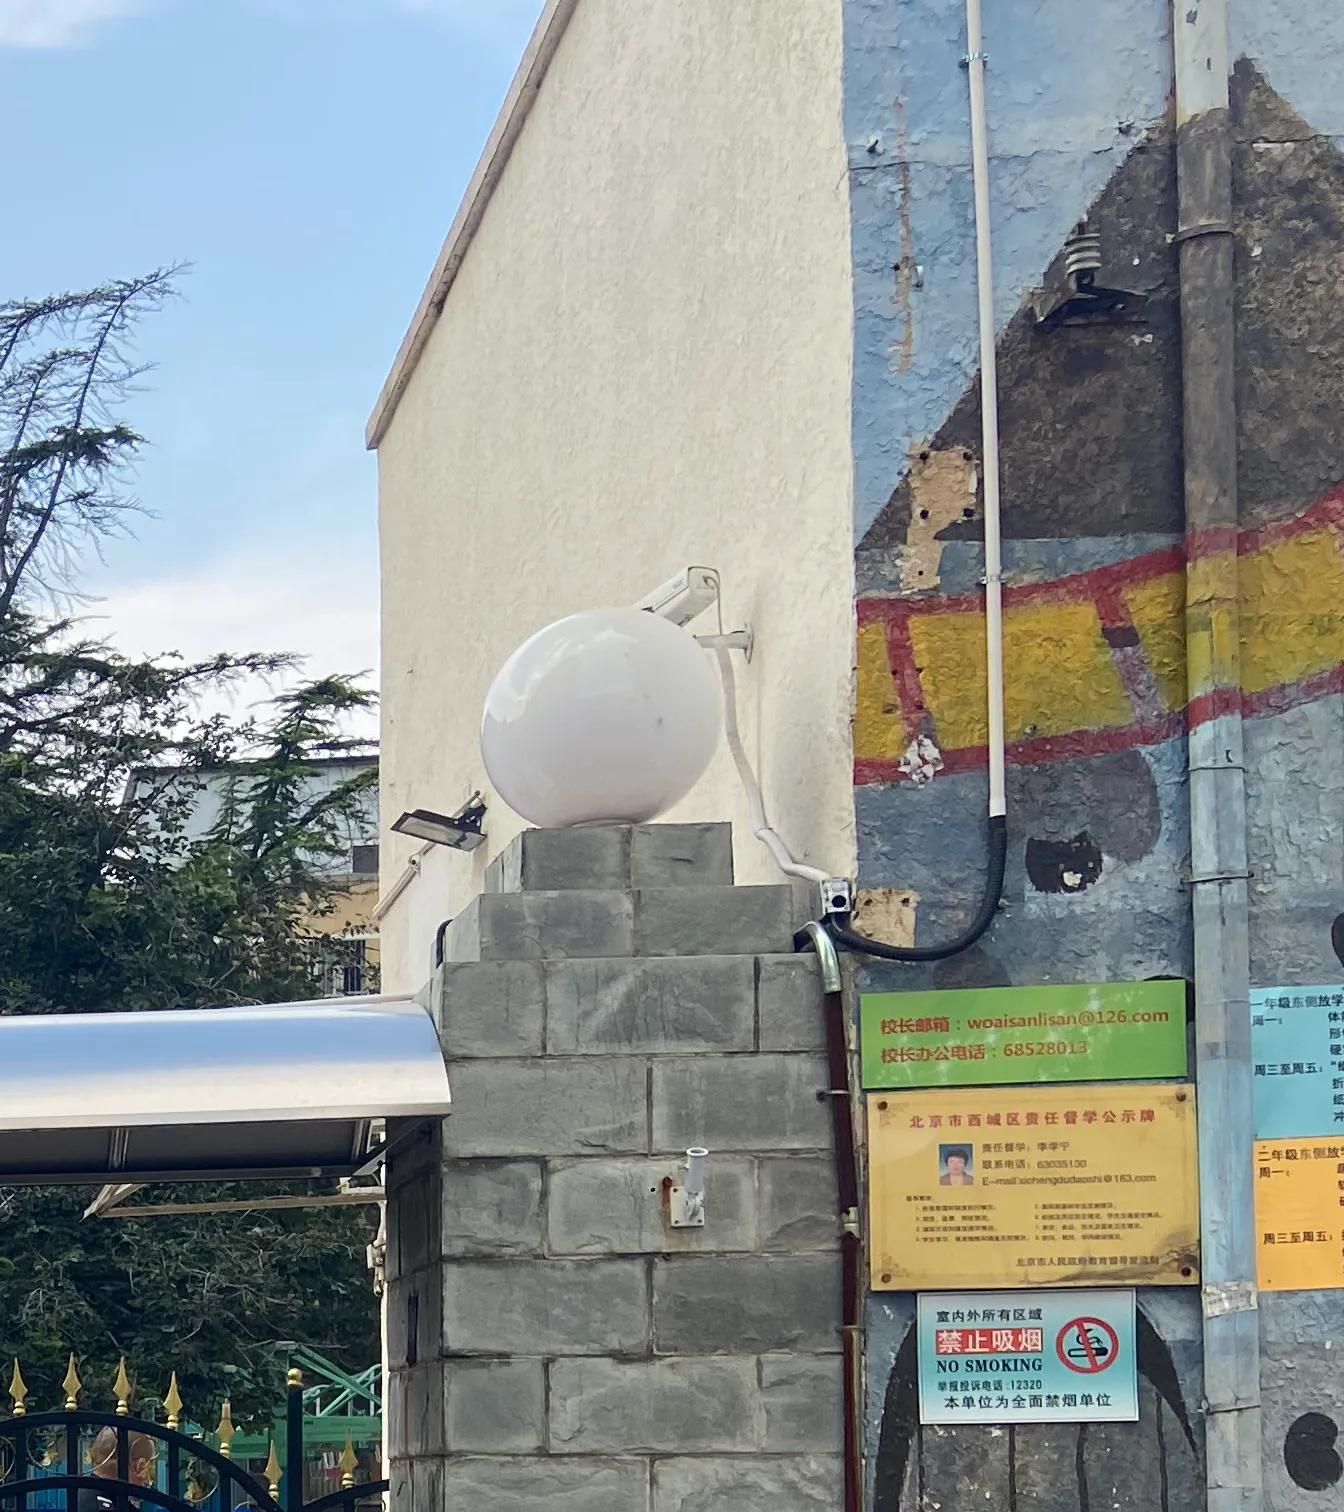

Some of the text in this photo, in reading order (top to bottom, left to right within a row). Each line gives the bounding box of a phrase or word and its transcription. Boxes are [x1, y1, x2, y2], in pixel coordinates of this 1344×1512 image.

[936, 1307, 1043, 1323] 室内外所有区域
[937, 1327, 1043, 1353] 禁止吸烟
[937, 1358, 1043, 1373] NO SMOKING
[944, 1393, 1112, 1410] 本单位为全面禁烟单位
